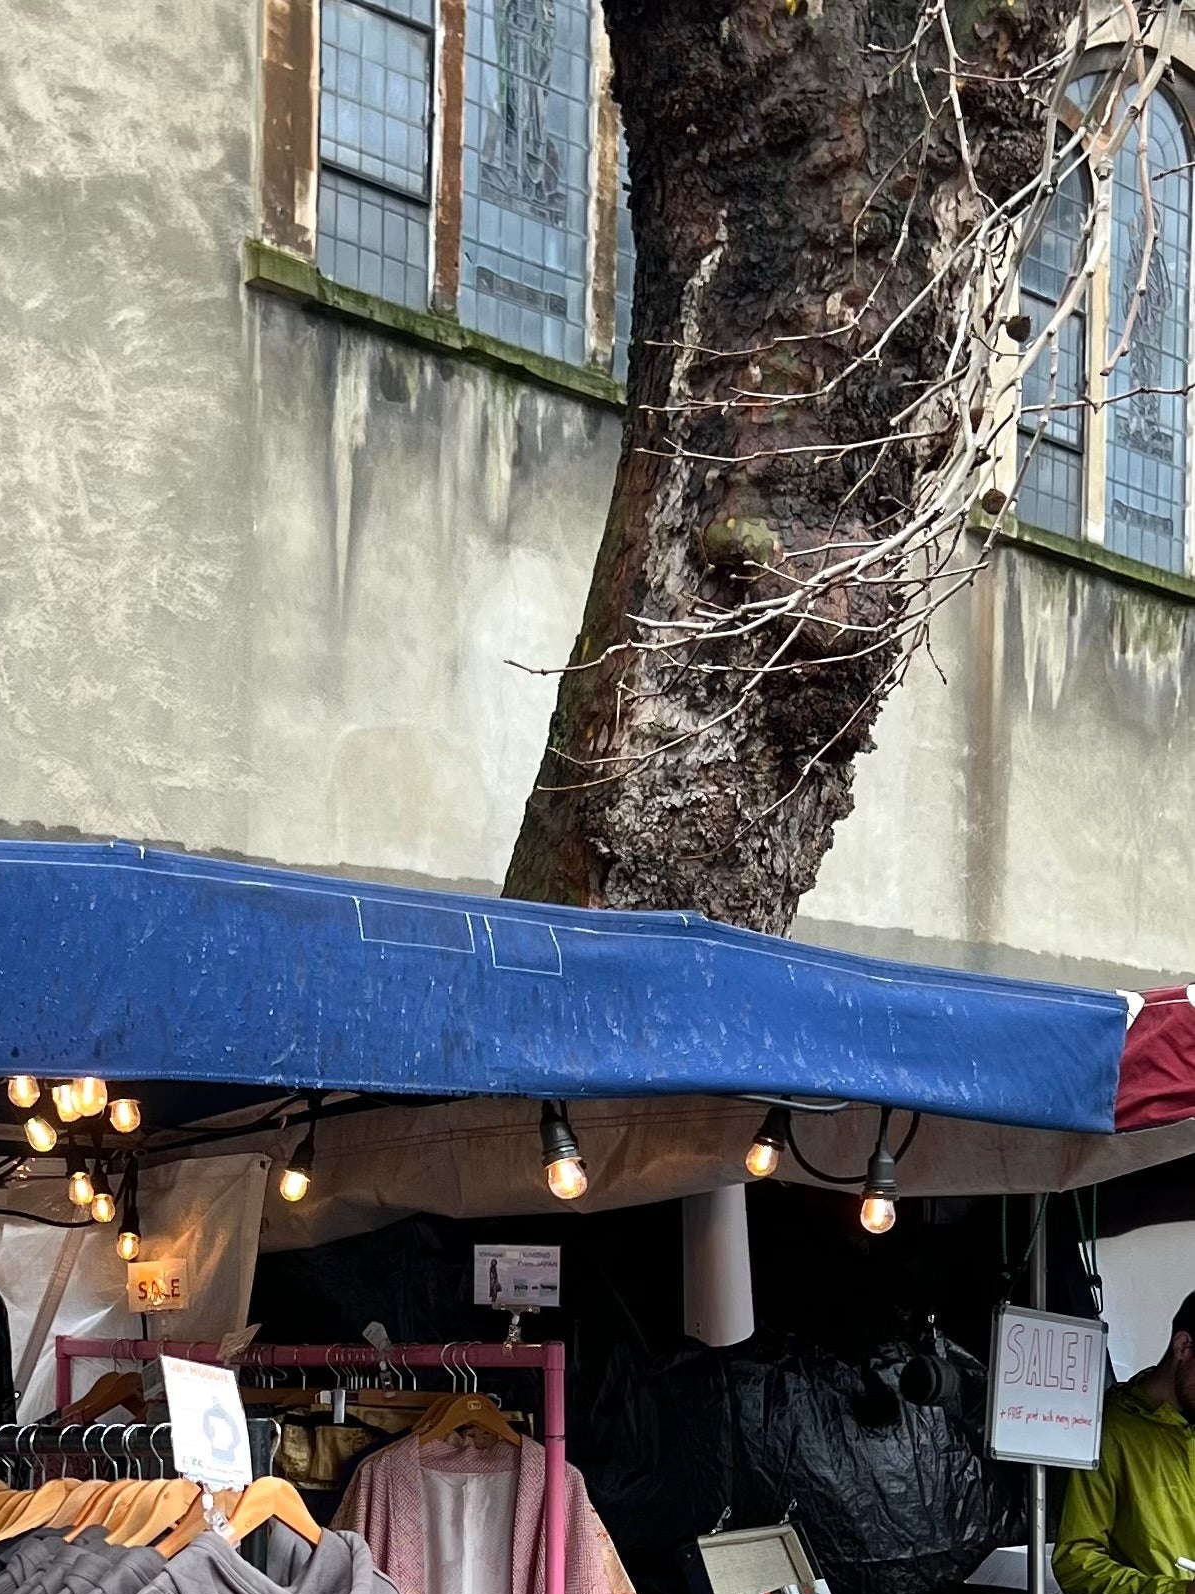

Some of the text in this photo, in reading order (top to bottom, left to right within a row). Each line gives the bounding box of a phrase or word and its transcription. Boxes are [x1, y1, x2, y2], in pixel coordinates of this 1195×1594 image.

[137, 1279, 180, 1300] SALE
[1004, 1323, 1093, 1393] SALE!
[1007, 1405, 1025, 1420] FREE
